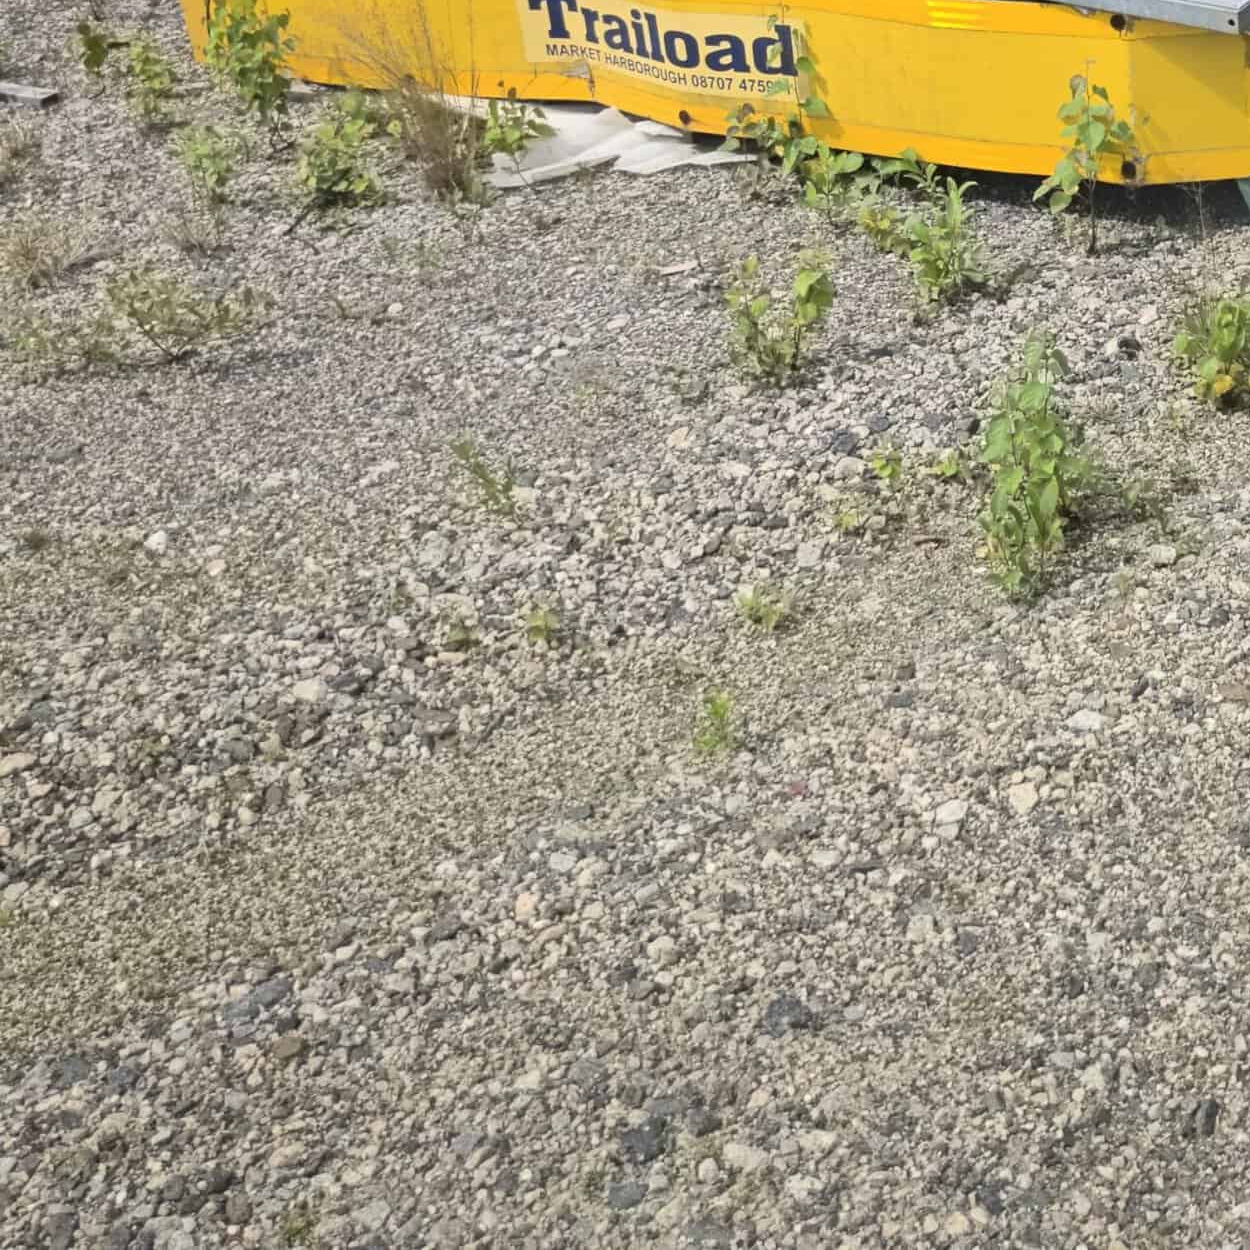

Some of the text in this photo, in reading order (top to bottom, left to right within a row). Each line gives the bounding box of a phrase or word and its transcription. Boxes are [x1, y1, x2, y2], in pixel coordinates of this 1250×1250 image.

[545, 43, 792, 95] MARKET HARBOROUGH 08707 4759
